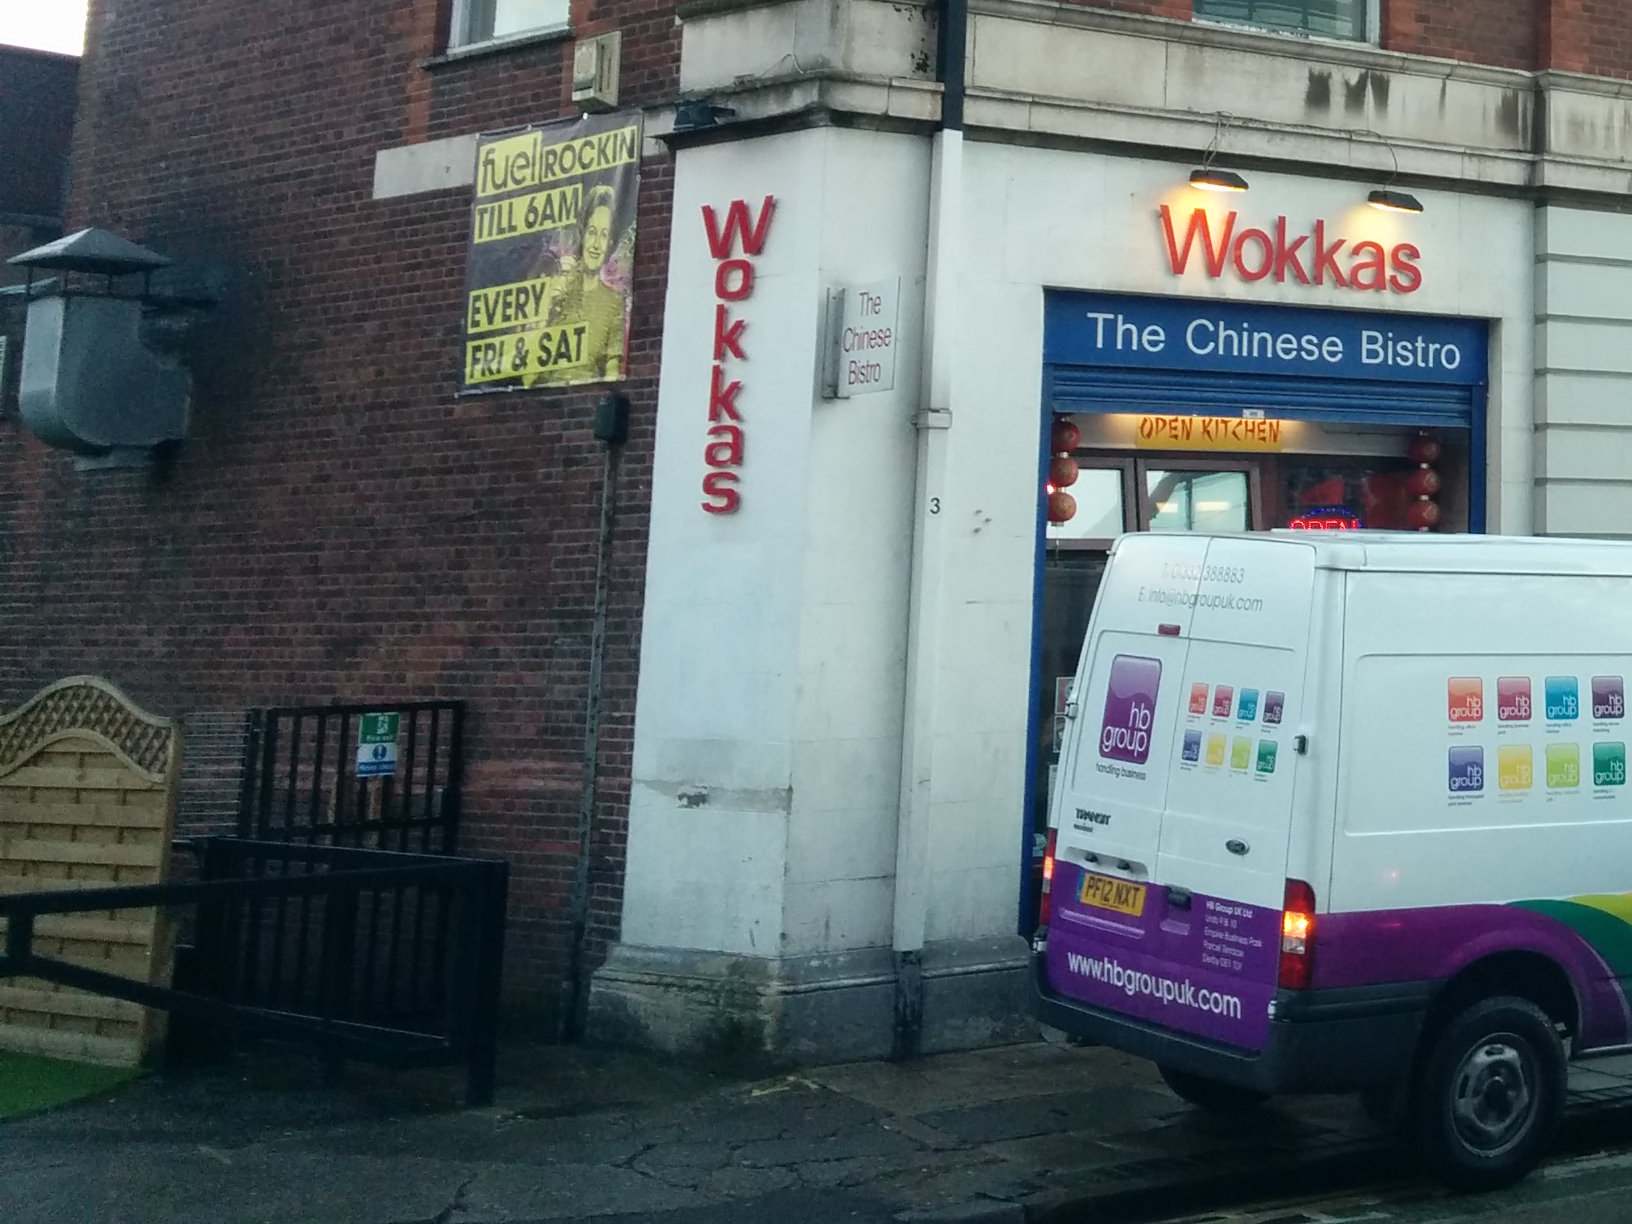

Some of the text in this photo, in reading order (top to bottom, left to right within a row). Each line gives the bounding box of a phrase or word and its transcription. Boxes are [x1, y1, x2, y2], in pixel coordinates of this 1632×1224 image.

[482, 137, 538, 193] fuel
[543, 129, 635, 178] ROCKIN
[477, 187, 579, 239] TILL 6AM
[1159, 204, 1423, 294] Wokkas
[471, 282, 546, 329] EVERY
[859, 292, 881, 316] The
[469, 326, 586, 379] FRI & SAT
[843, 326, 892, 353] Chinese
[1086, 311, 1461, 370] The Chinese Bistro
[701, 194, 775, 515] Wokkas
[848, 359, 881, 385] Bistro
[1138, 415, 1281, 444] OPEN KITCHEN
[928, 496, 941, 516] 3
[1466, 695, 1481, 707] hb
[1515, 695, 1530, 707] hb
[1548, 705, 1577, 718] group
[1563, 694, 1577, 706] hb
[1594, 705, 1623, 717] group
[1609, 693, 1623, 705] hb
[1129, 701, 1151, 730] hb
[1450, 707, 1481, 720] group
[1500, 706, 1530, 719] group
[1102, 726, 1147, 757] group
[1467, 764, 1482, 776] hb
[1595, 771, 1624, 784] group
[1610, 760, 1624, 772] hb
[1451, 776, 1481, 790] group
[1085, 876, 1140, 908] PF12 NXT
[1067, 951, 1242, 1019] www.hbgroupuk.com
